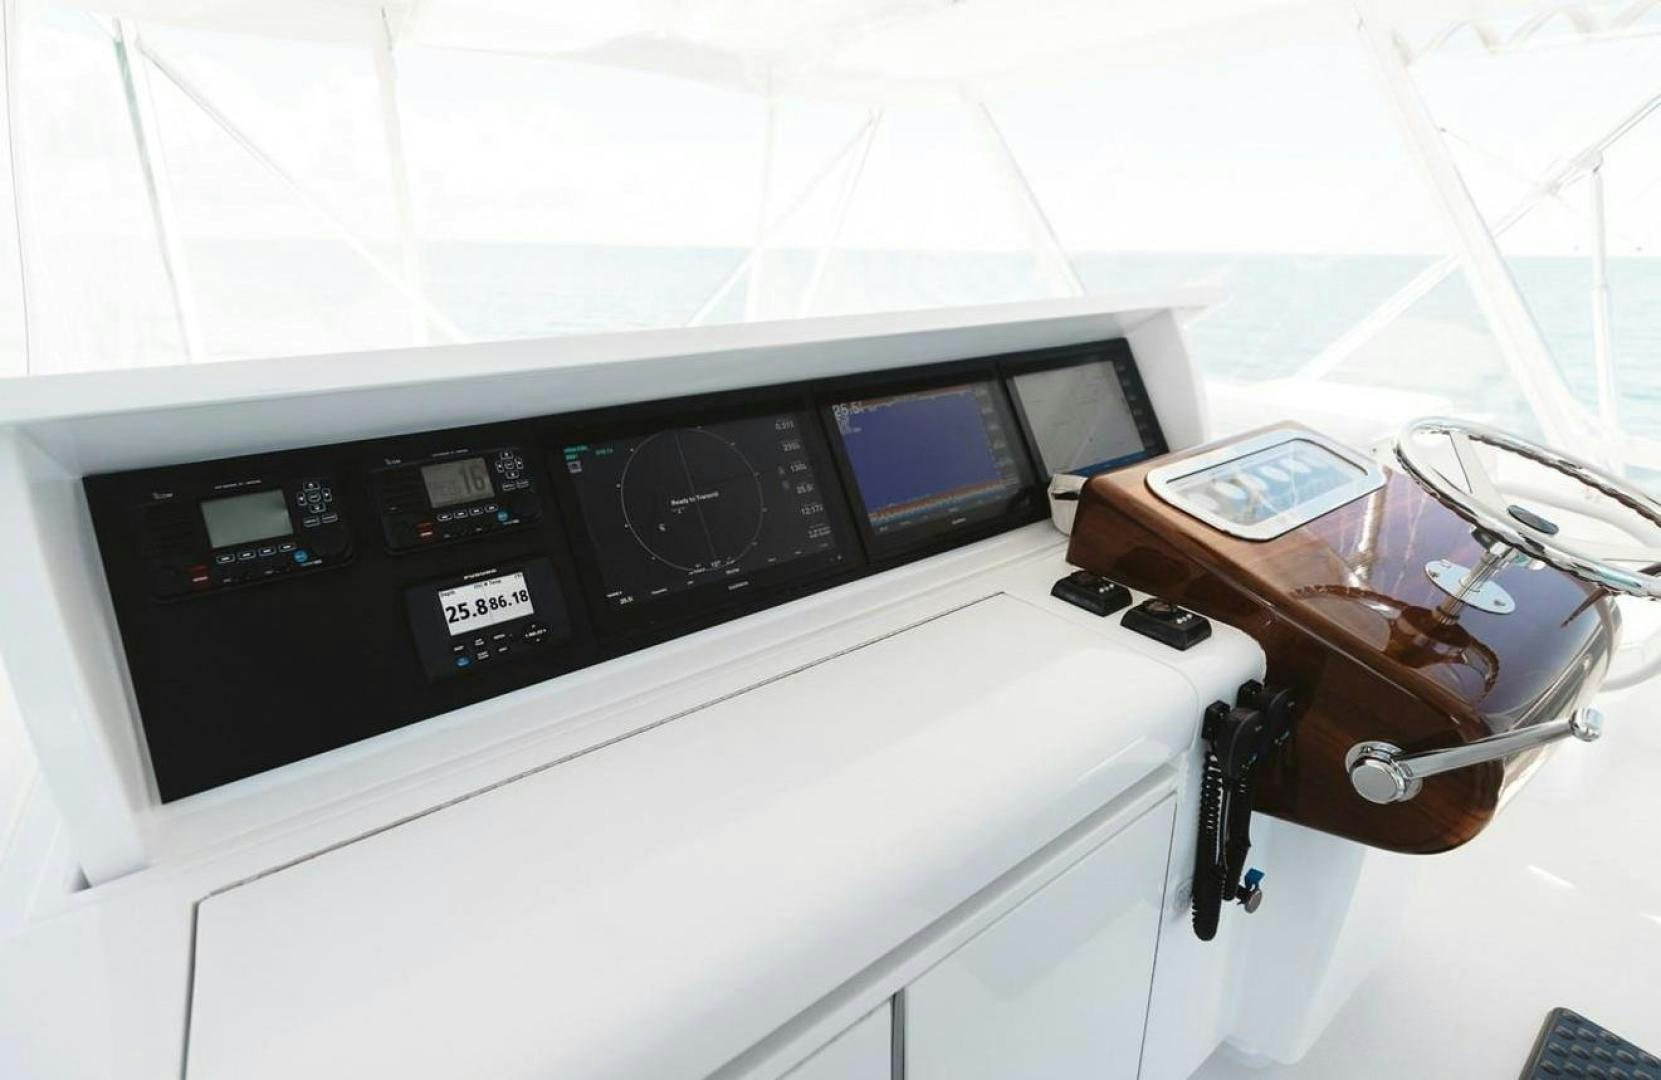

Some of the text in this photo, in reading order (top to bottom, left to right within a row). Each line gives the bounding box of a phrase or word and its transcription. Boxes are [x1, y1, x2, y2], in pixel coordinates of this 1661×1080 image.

[459, 465, 486, 493] 16
[445, 598, 488, 624] 25.8
[488, 589, 529, 611] 86.18
